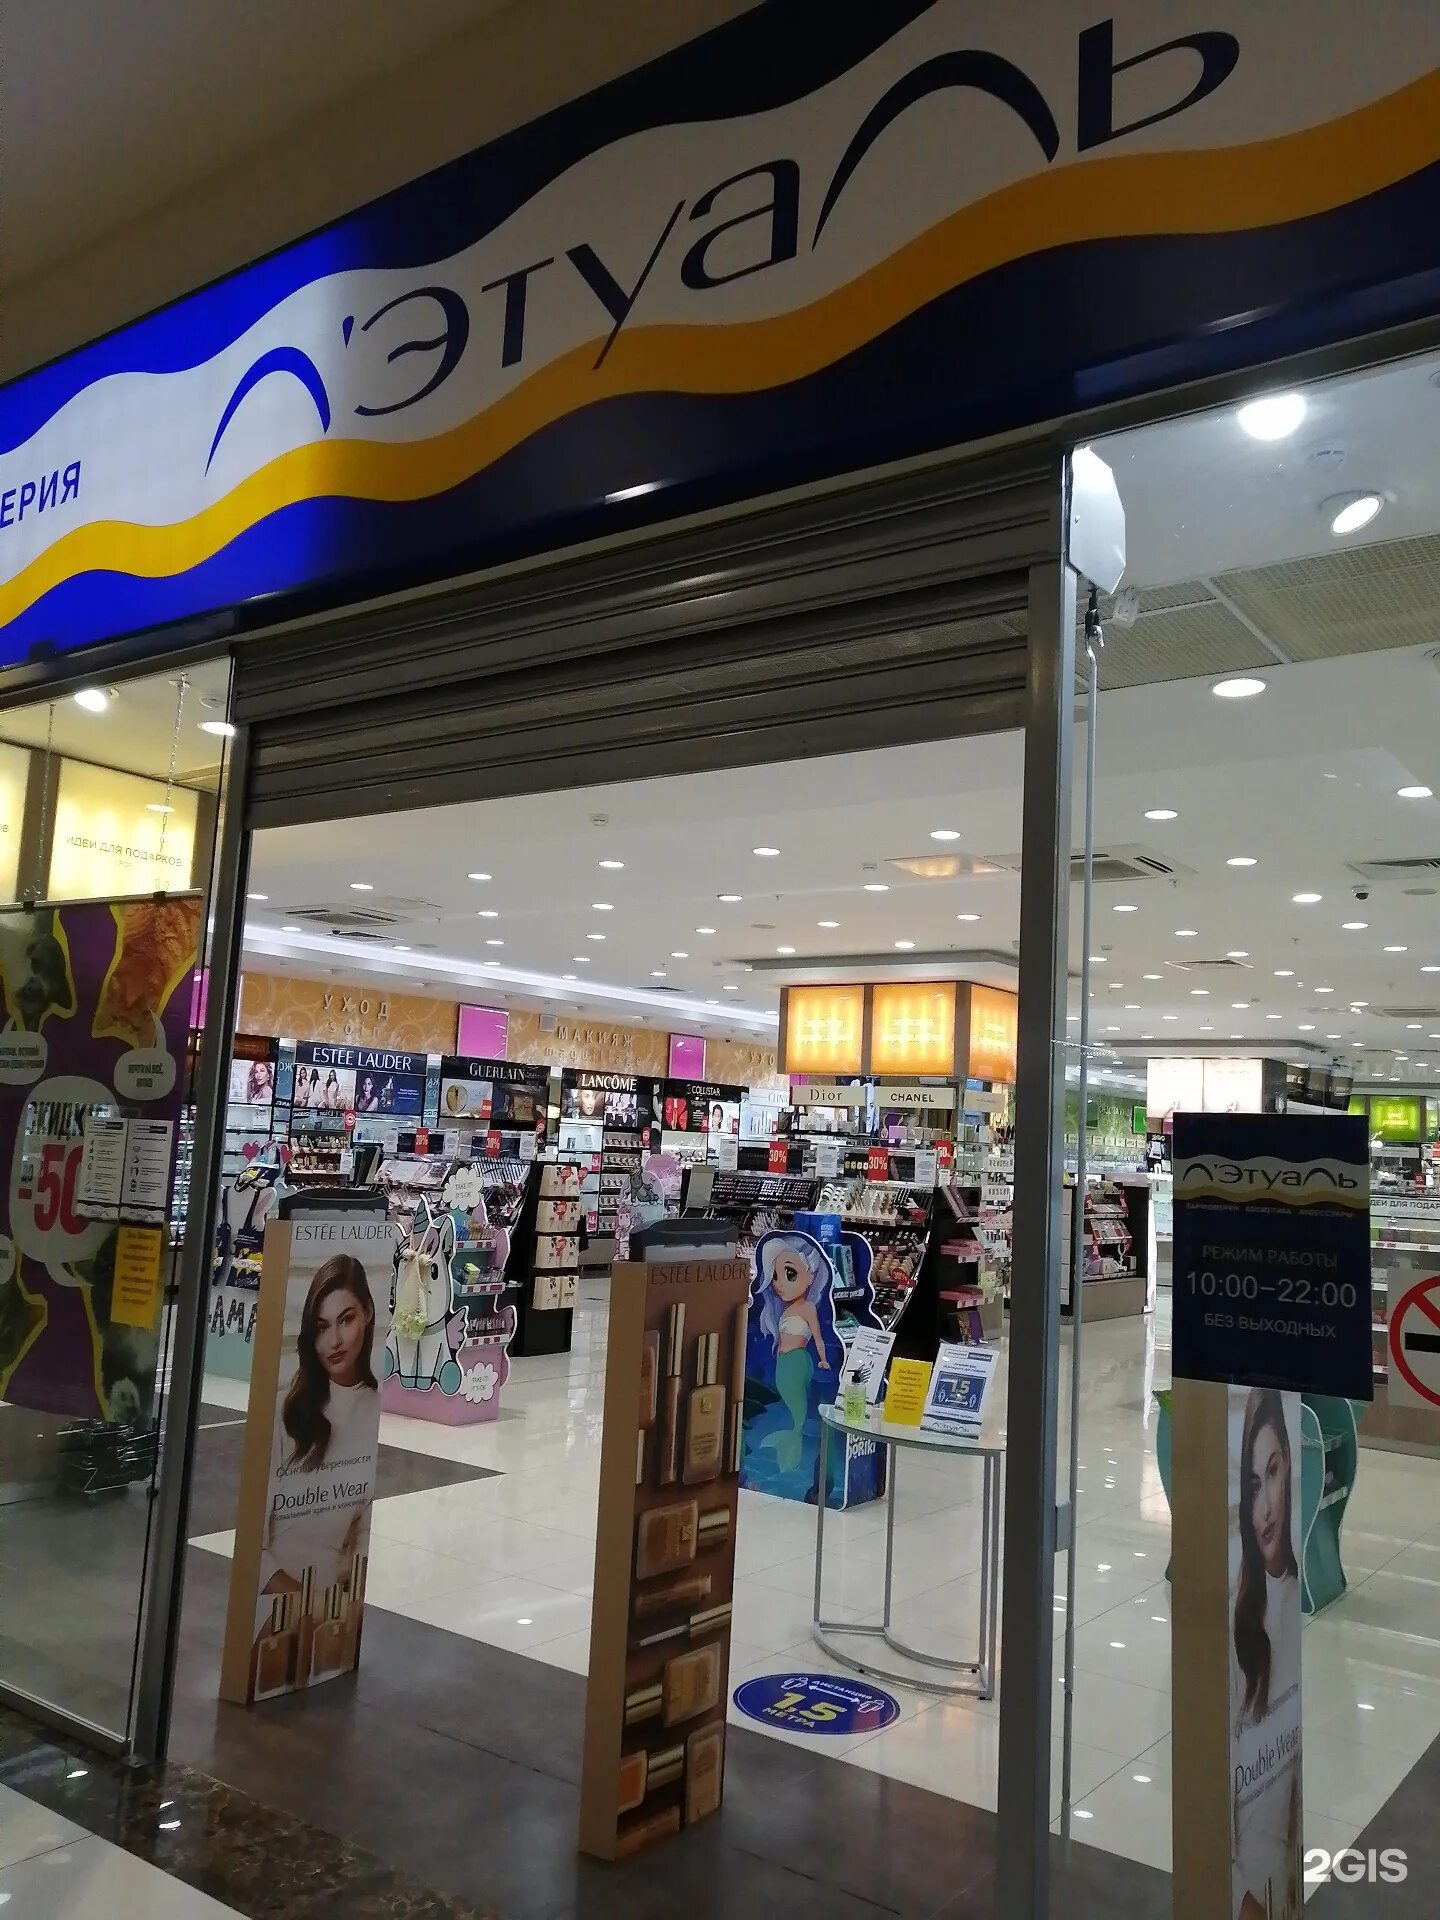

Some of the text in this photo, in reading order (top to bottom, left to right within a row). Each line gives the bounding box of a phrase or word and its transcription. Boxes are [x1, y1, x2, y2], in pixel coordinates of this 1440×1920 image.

[0, 461, 81, 529] ЕРИЯ
[322, 994, 389, 1020] УХОД
[558, 1025, 633, 1047] МАКИЯЖ
[358, 1052, 411, 1071] LAUDER
[469, 1062, 525, 1081] GUERLAIN
[581, 1073, 638, 1092] LANCÔME
[691, 1085, 721, 1096] COLLISTAR
[810, 1088, 843, 1101] Dior
[890, 1093, 935, 1103] CHANEL
[769, 1149, 786, 1163] 30%
[868, 1156, 888, 1171] 30%
[341, 1225, 393, 1240] LAUDER
[1202, 1245, 1338, 1268] РЕЖИМ РАБОТЫ
[697, 1263, 748, 1283] LAUDER
[1204, 1313, 1336, 1338] БЕЗ ВЫХОДНЫХ
[273, 1481, 369, 1511] Double Wear
[762, 1706, 815, 1728] МЕТРА
[1235, 1743, 1275, 1794] Double
[1276, 1726, 1299, 1760] Wear
